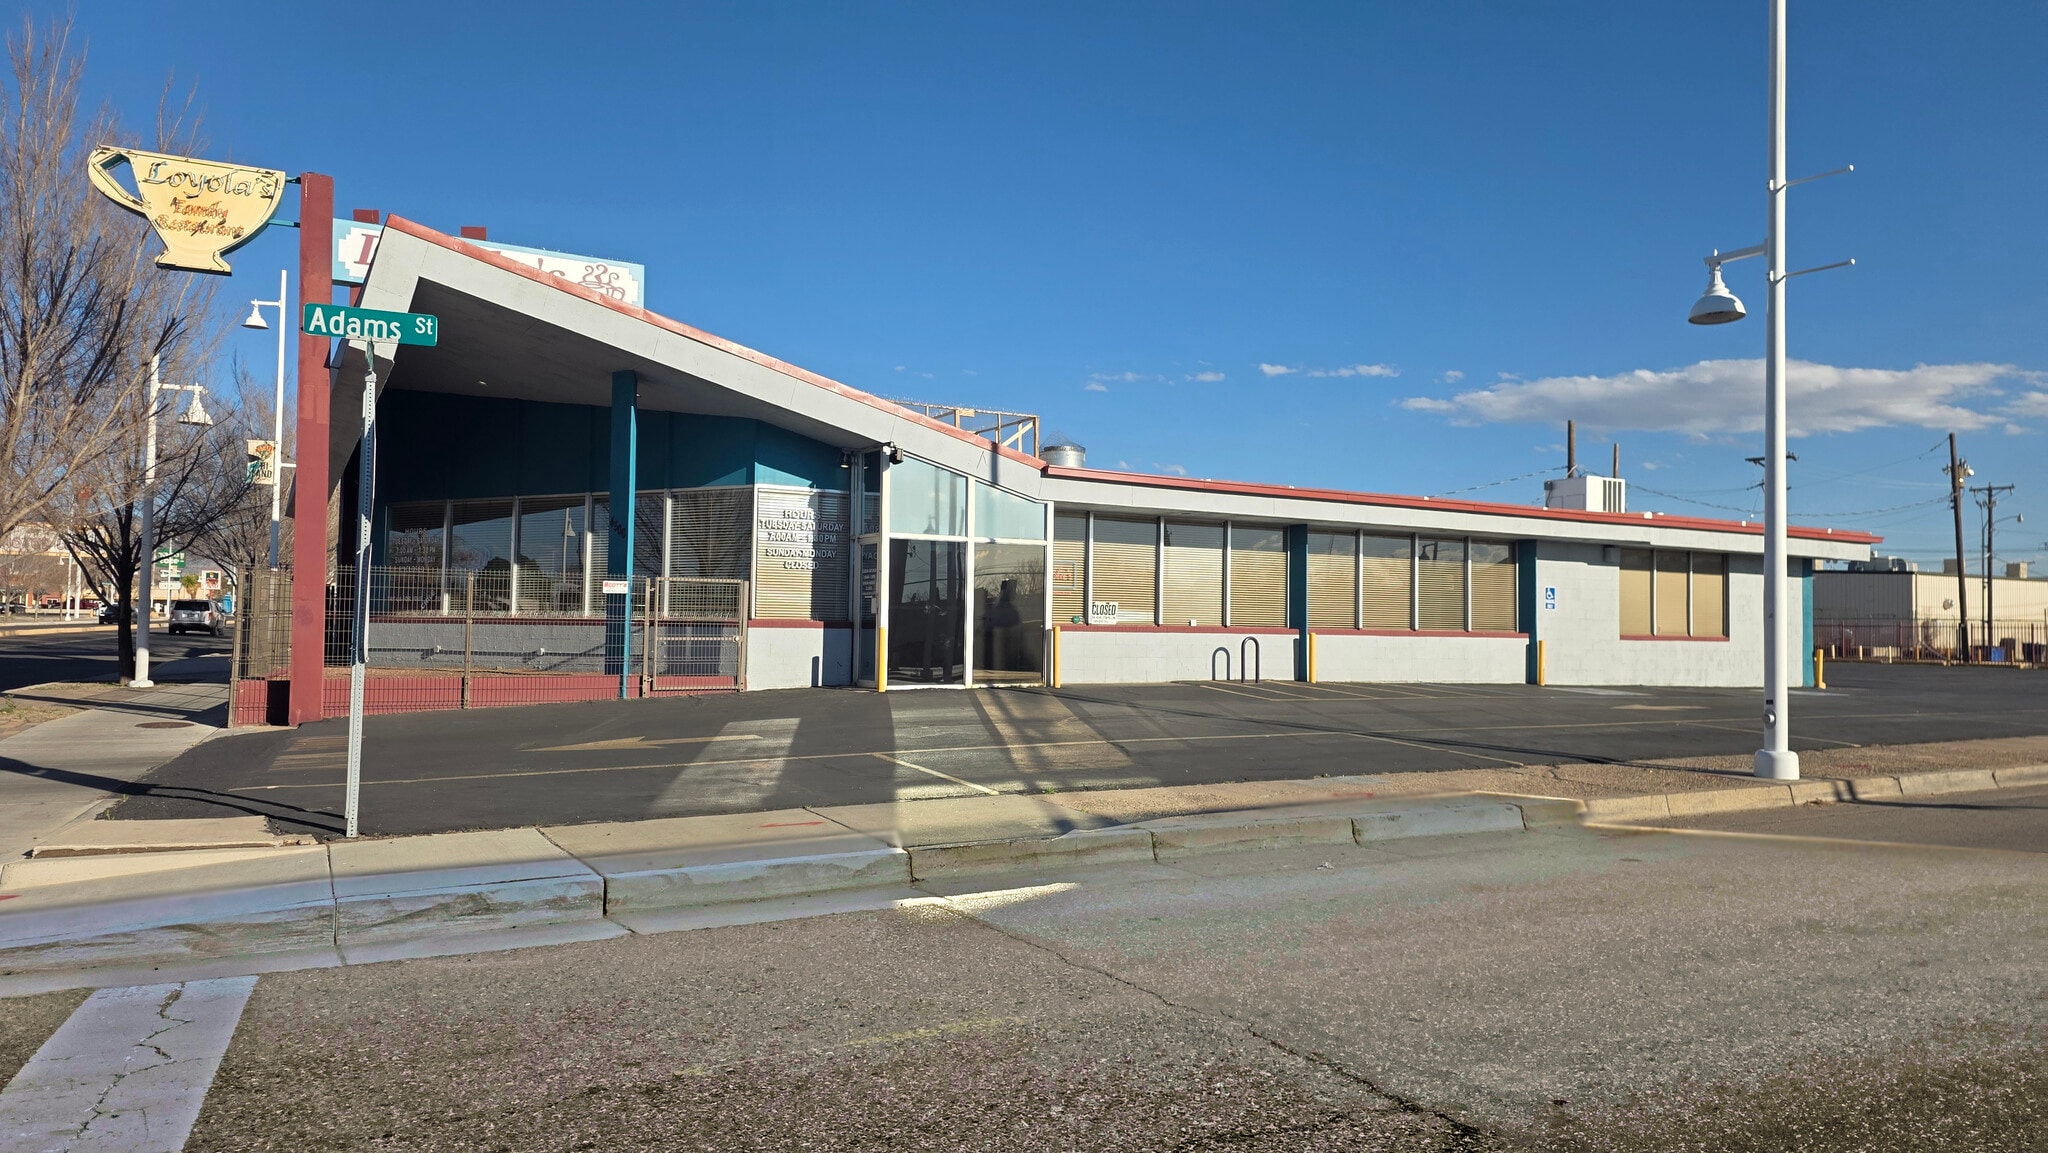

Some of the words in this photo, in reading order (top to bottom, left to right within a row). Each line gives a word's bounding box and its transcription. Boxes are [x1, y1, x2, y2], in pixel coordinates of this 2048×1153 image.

[142, 161, 276, 199] Loyola's
[172, 197, 229, 221] Family
[308, 306, 401, 341] Adams
[414, 315, 434, 335] St
[784, 509, 821, 519] HOURS
[404, 527, 428, 535] HOURS
[784, 561, 819, 570] CLOSED
[1091, 604, 1117, 615] CLOSED
